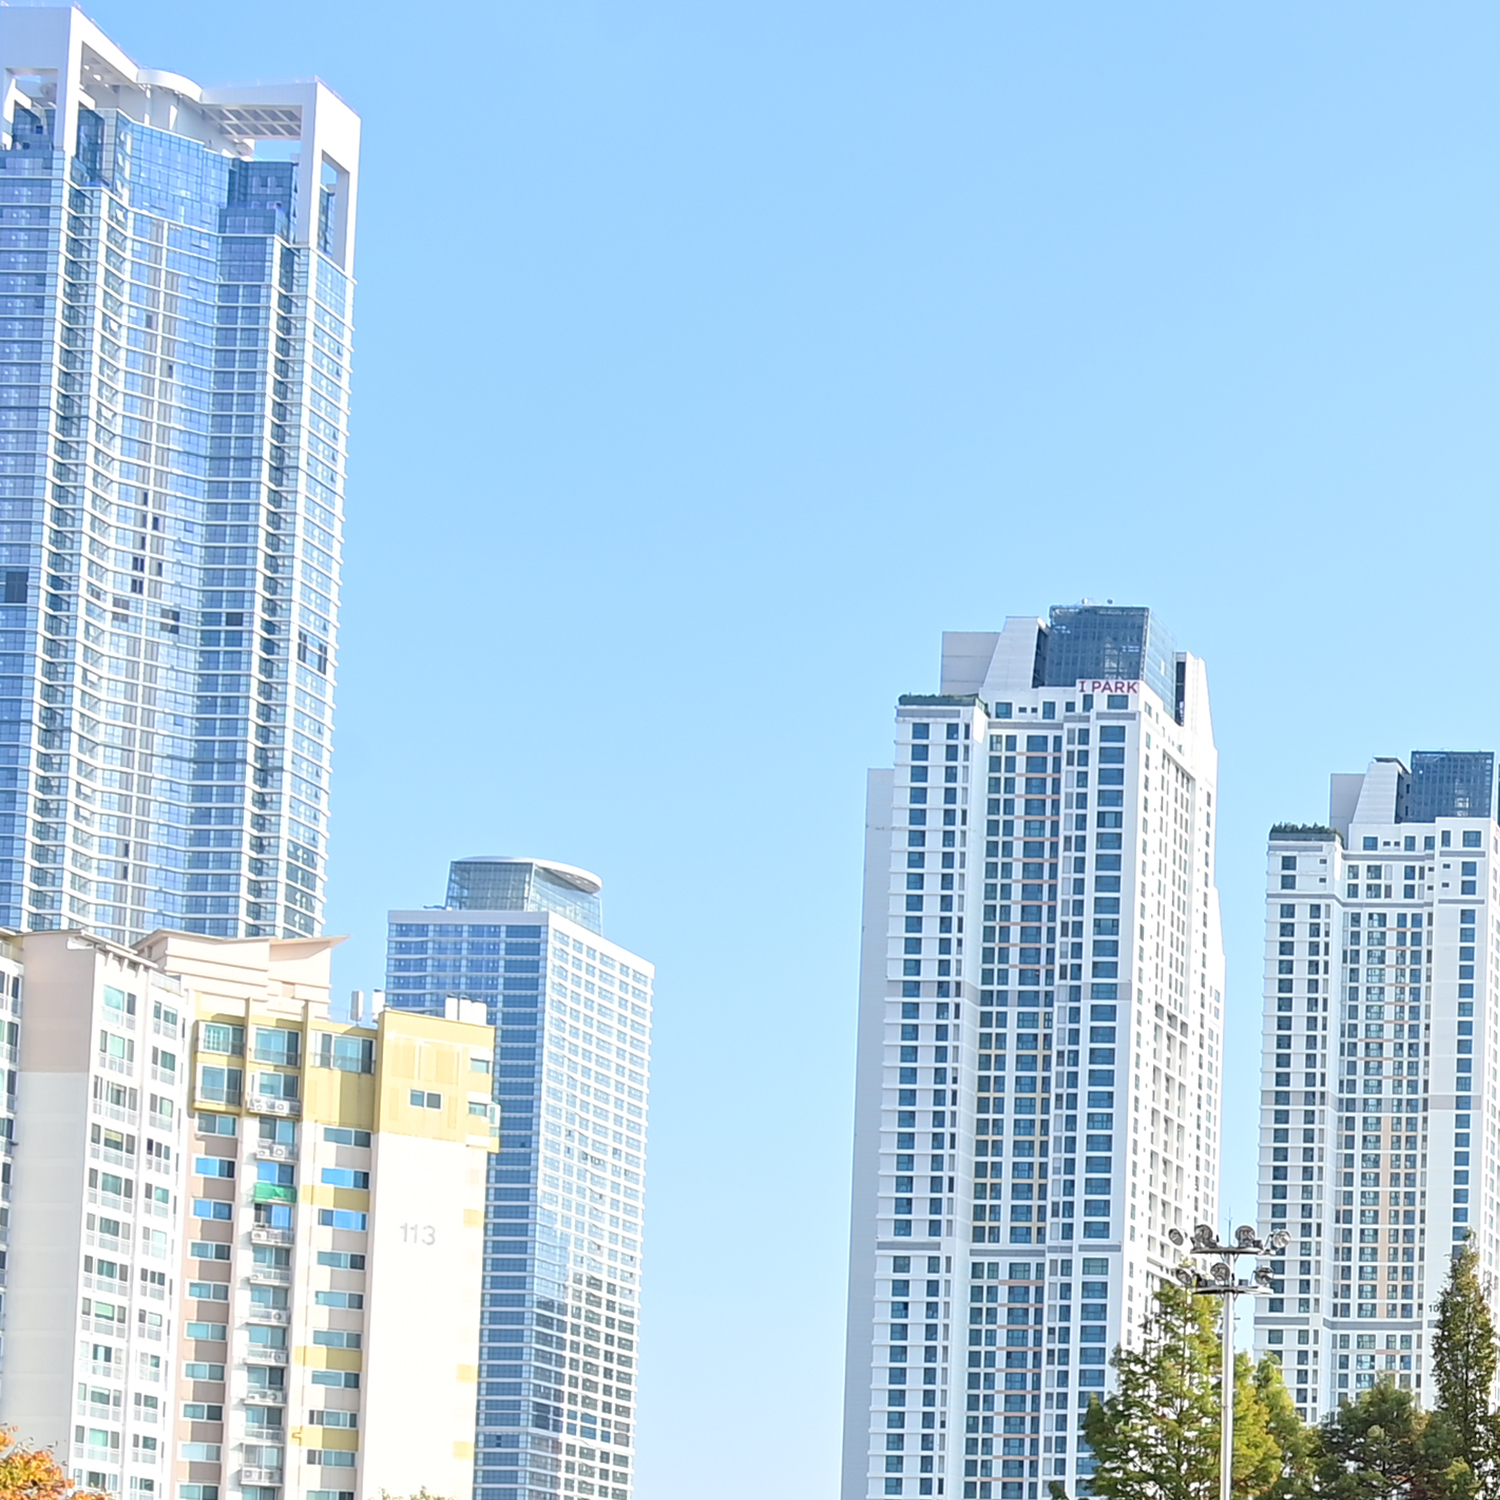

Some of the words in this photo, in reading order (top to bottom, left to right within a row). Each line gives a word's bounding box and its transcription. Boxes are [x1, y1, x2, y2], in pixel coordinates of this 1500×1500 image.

[1079, 681, 1086, 693] I
[1092, 681, 1138, 694] PARK
[400, 1222, 436, 1246] 113
